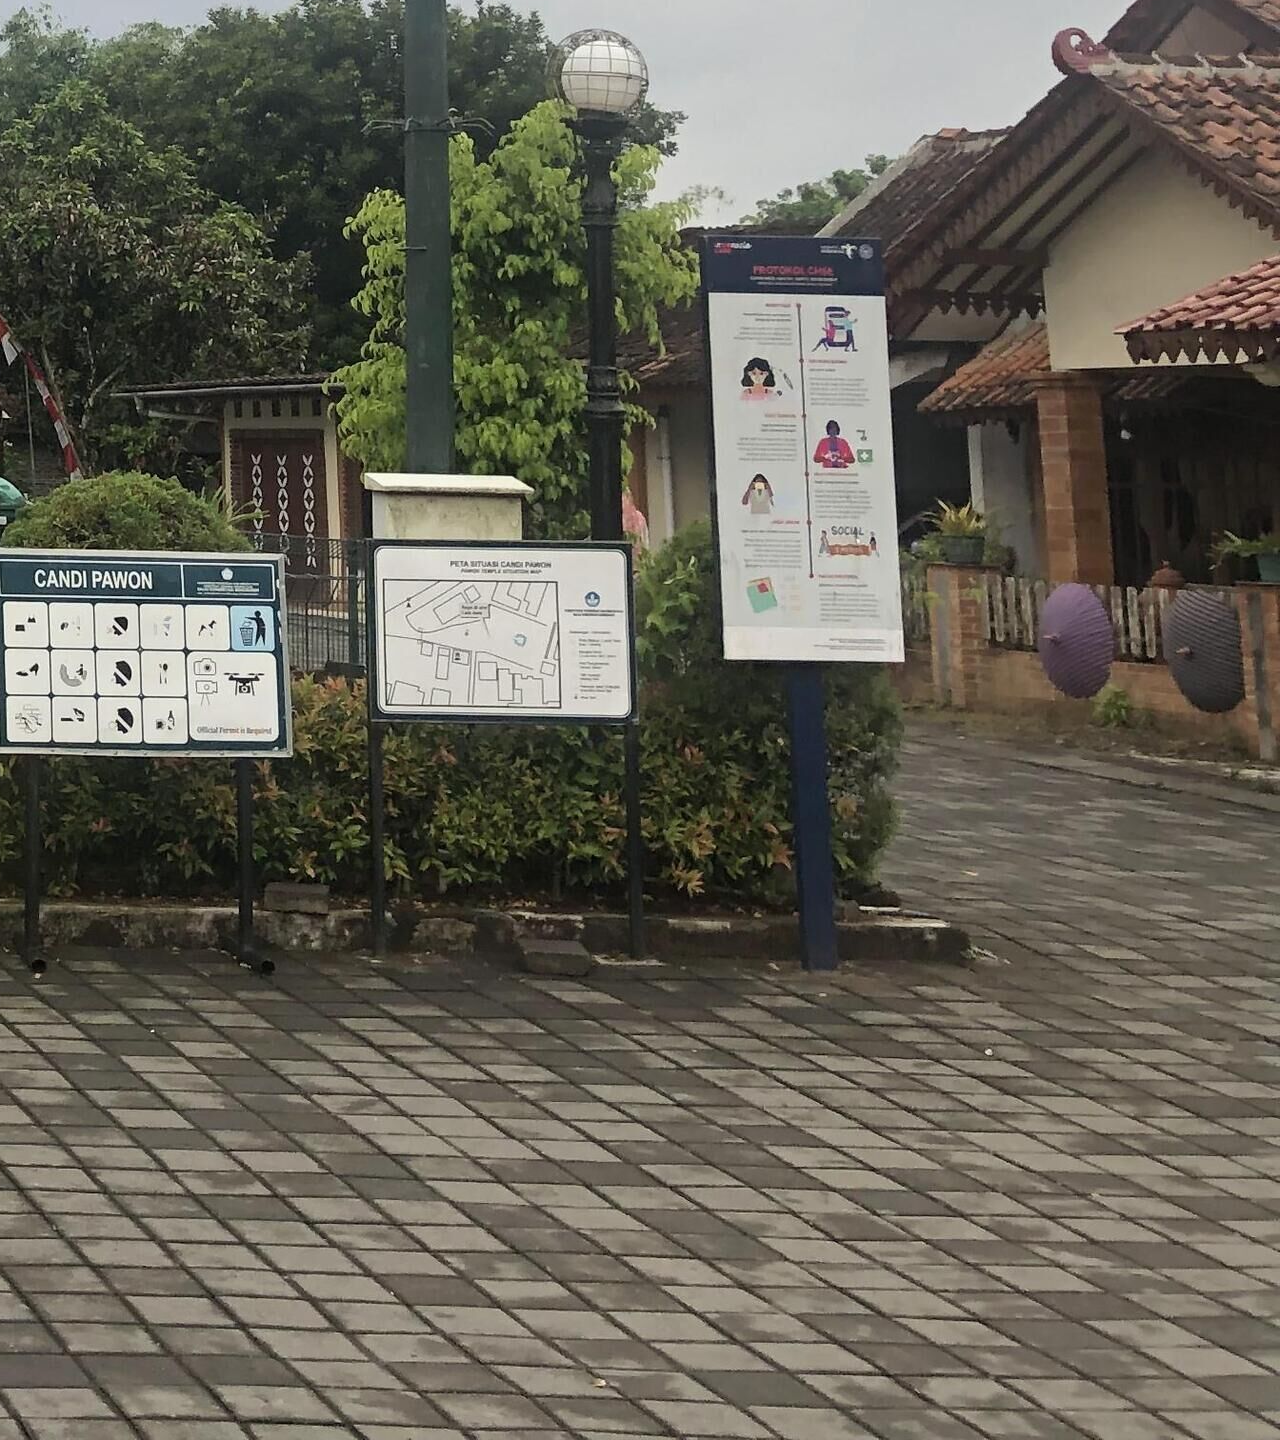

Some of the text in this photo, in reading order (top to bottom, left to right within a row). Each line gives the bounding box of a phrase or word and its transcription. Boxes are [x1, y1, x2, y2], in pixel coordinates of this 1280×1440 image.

[831, 526, 864, 536] SOCIAL
[34, 569, 153, 590] CANDI PAWON
